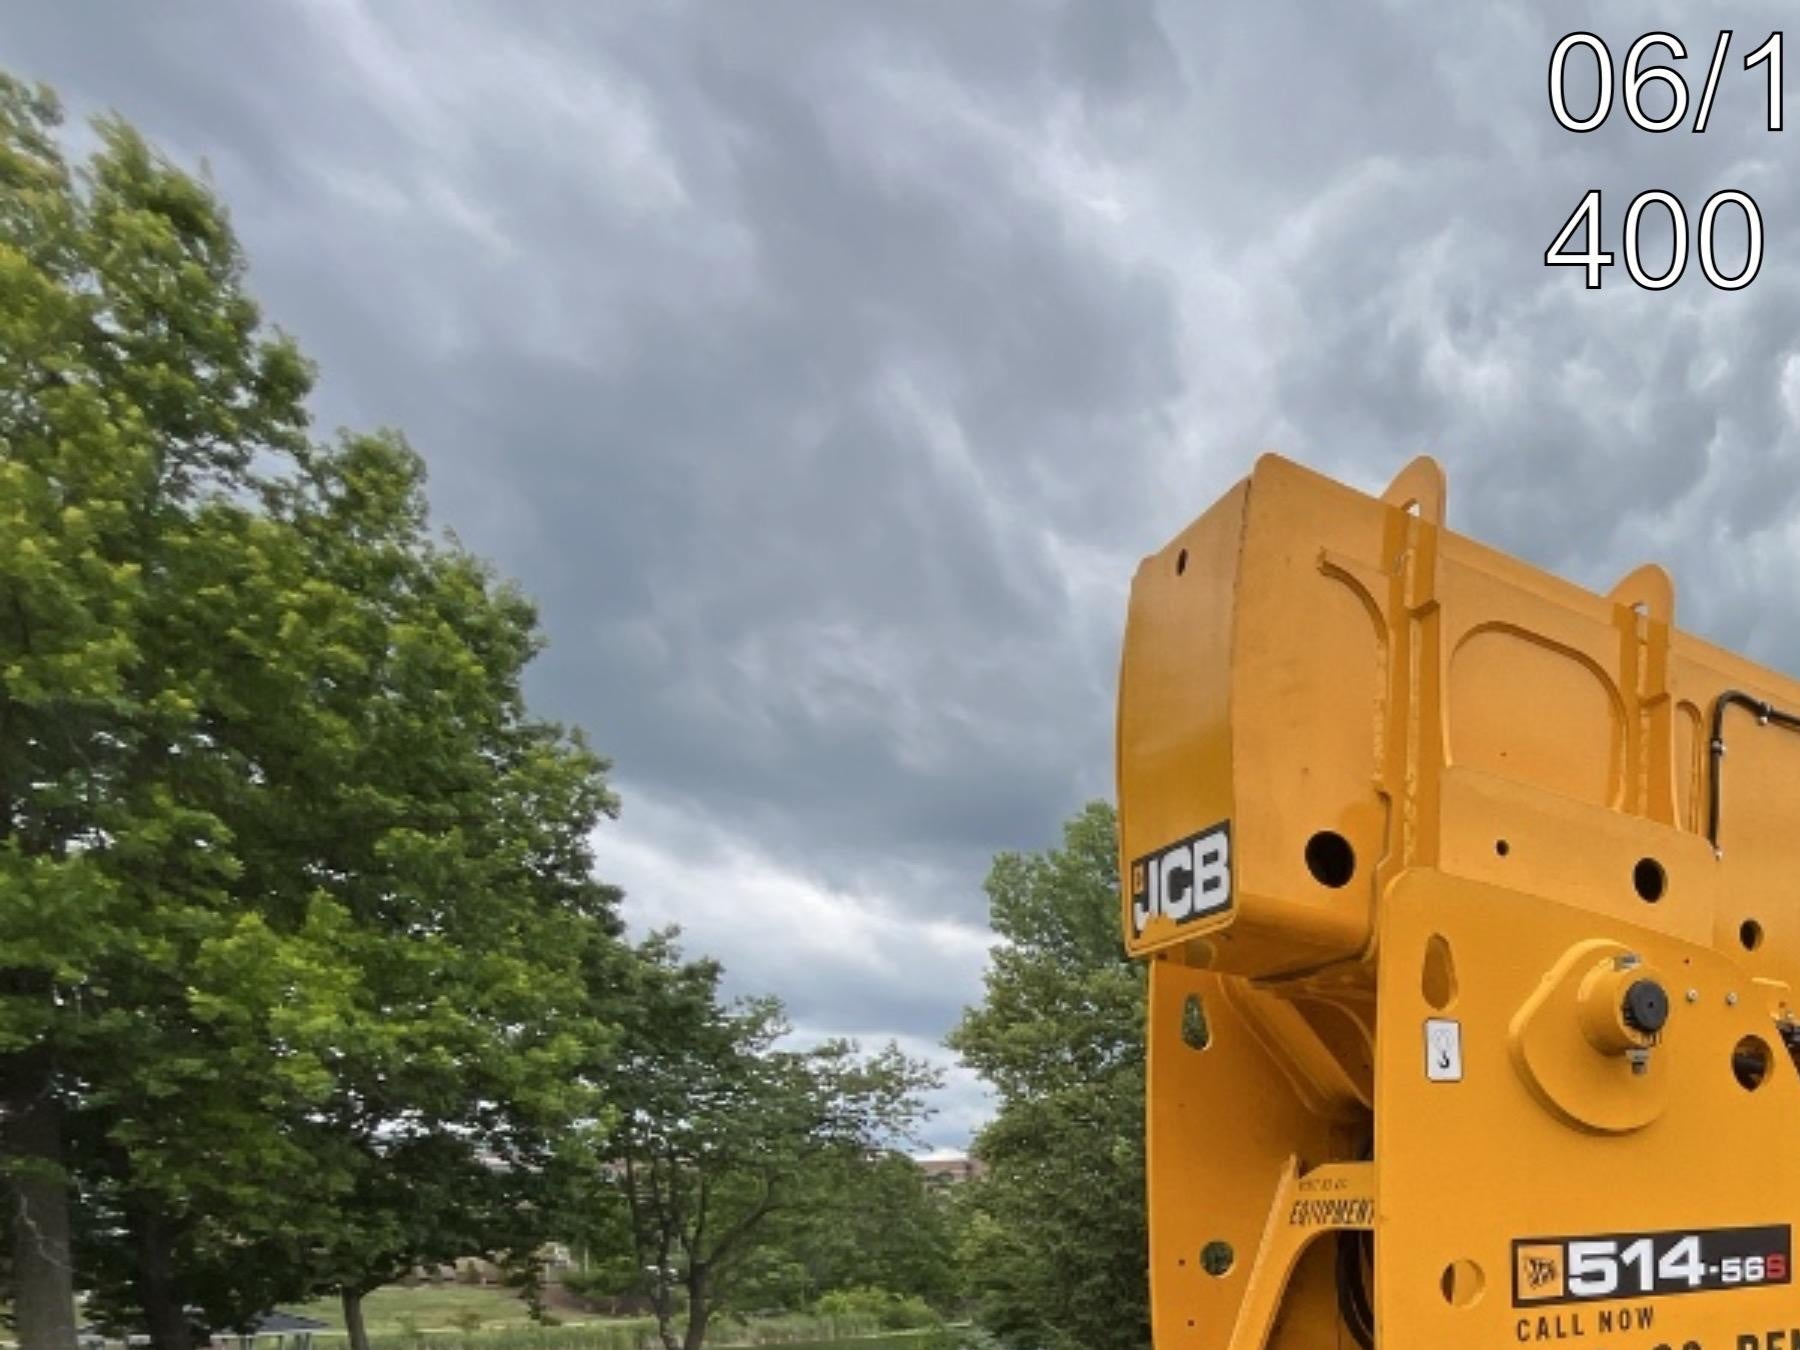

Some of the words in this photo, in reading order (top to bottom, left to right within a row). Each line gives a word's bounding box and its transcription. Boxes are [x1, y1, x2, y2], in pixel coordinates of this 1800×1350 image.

[1133, 829, 1232, 932] JCB
[1516, 1312, 1585, 1342] CALL
[1599, 1305, 1655, 1333] NOW
